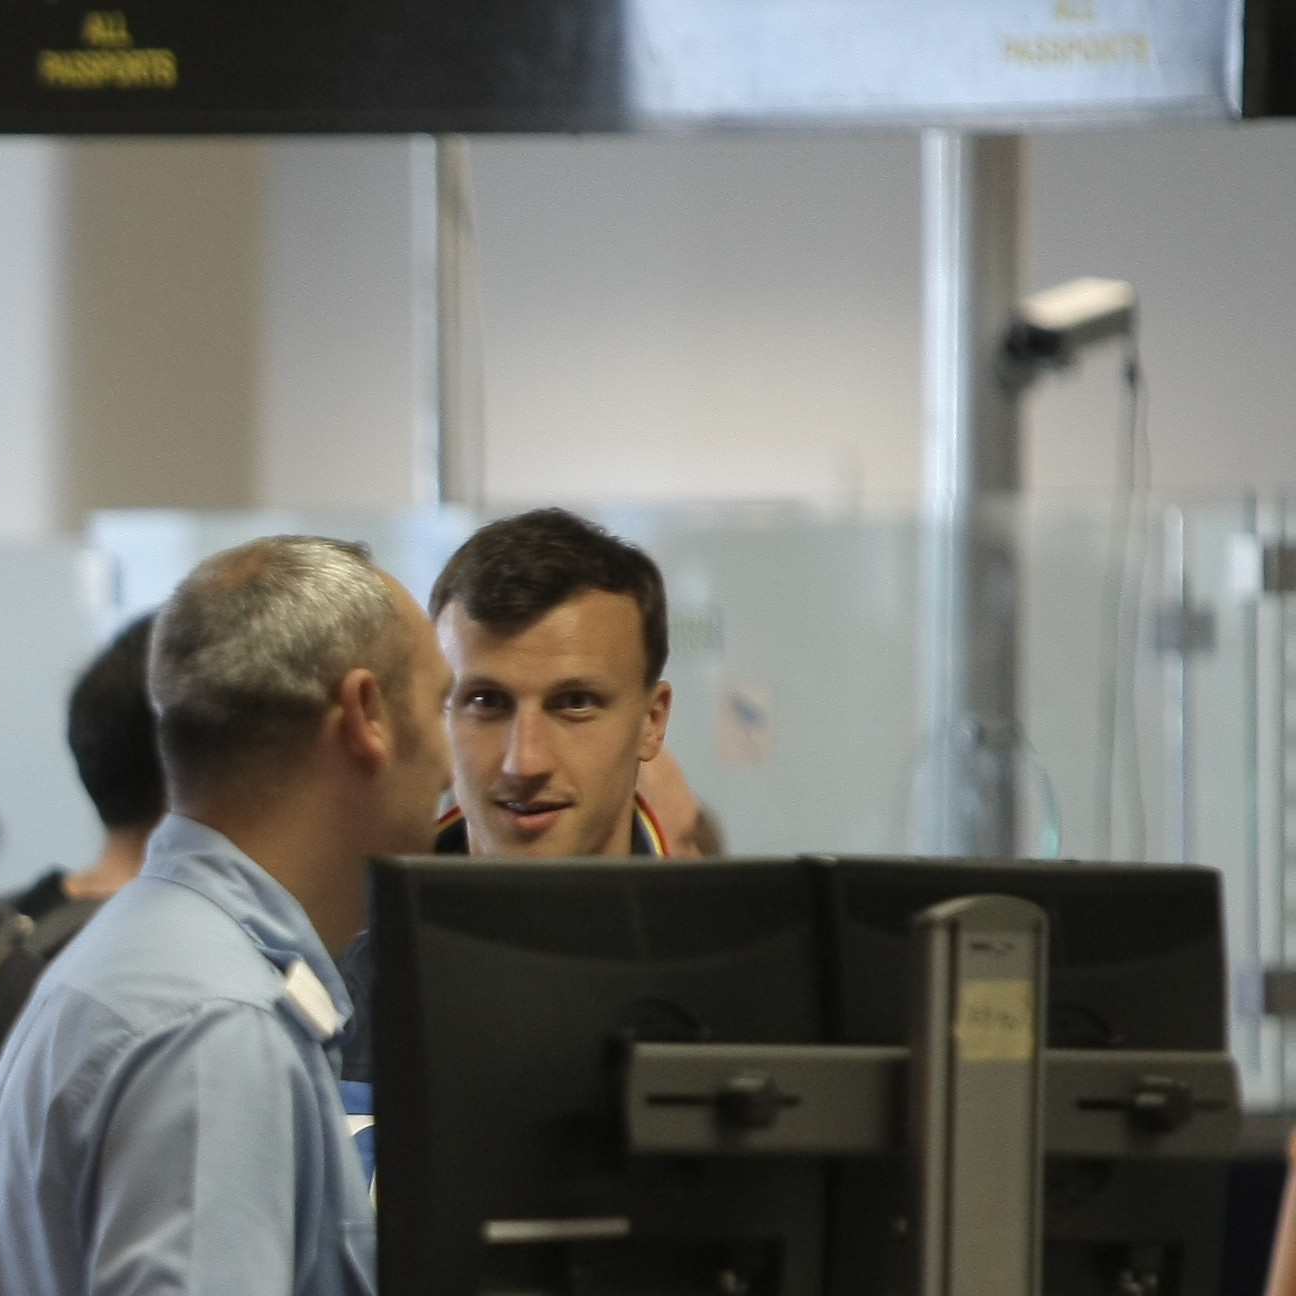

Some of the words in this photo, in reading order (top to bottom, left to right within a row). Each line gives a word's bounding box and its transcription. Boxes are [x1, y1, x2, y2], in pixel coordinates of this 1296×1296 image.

[83, 10, 132, 47] ALL
[39, 48, 178, 88] PASSPORTS
[1005, 33, 1149, 67] PASSPORTS
